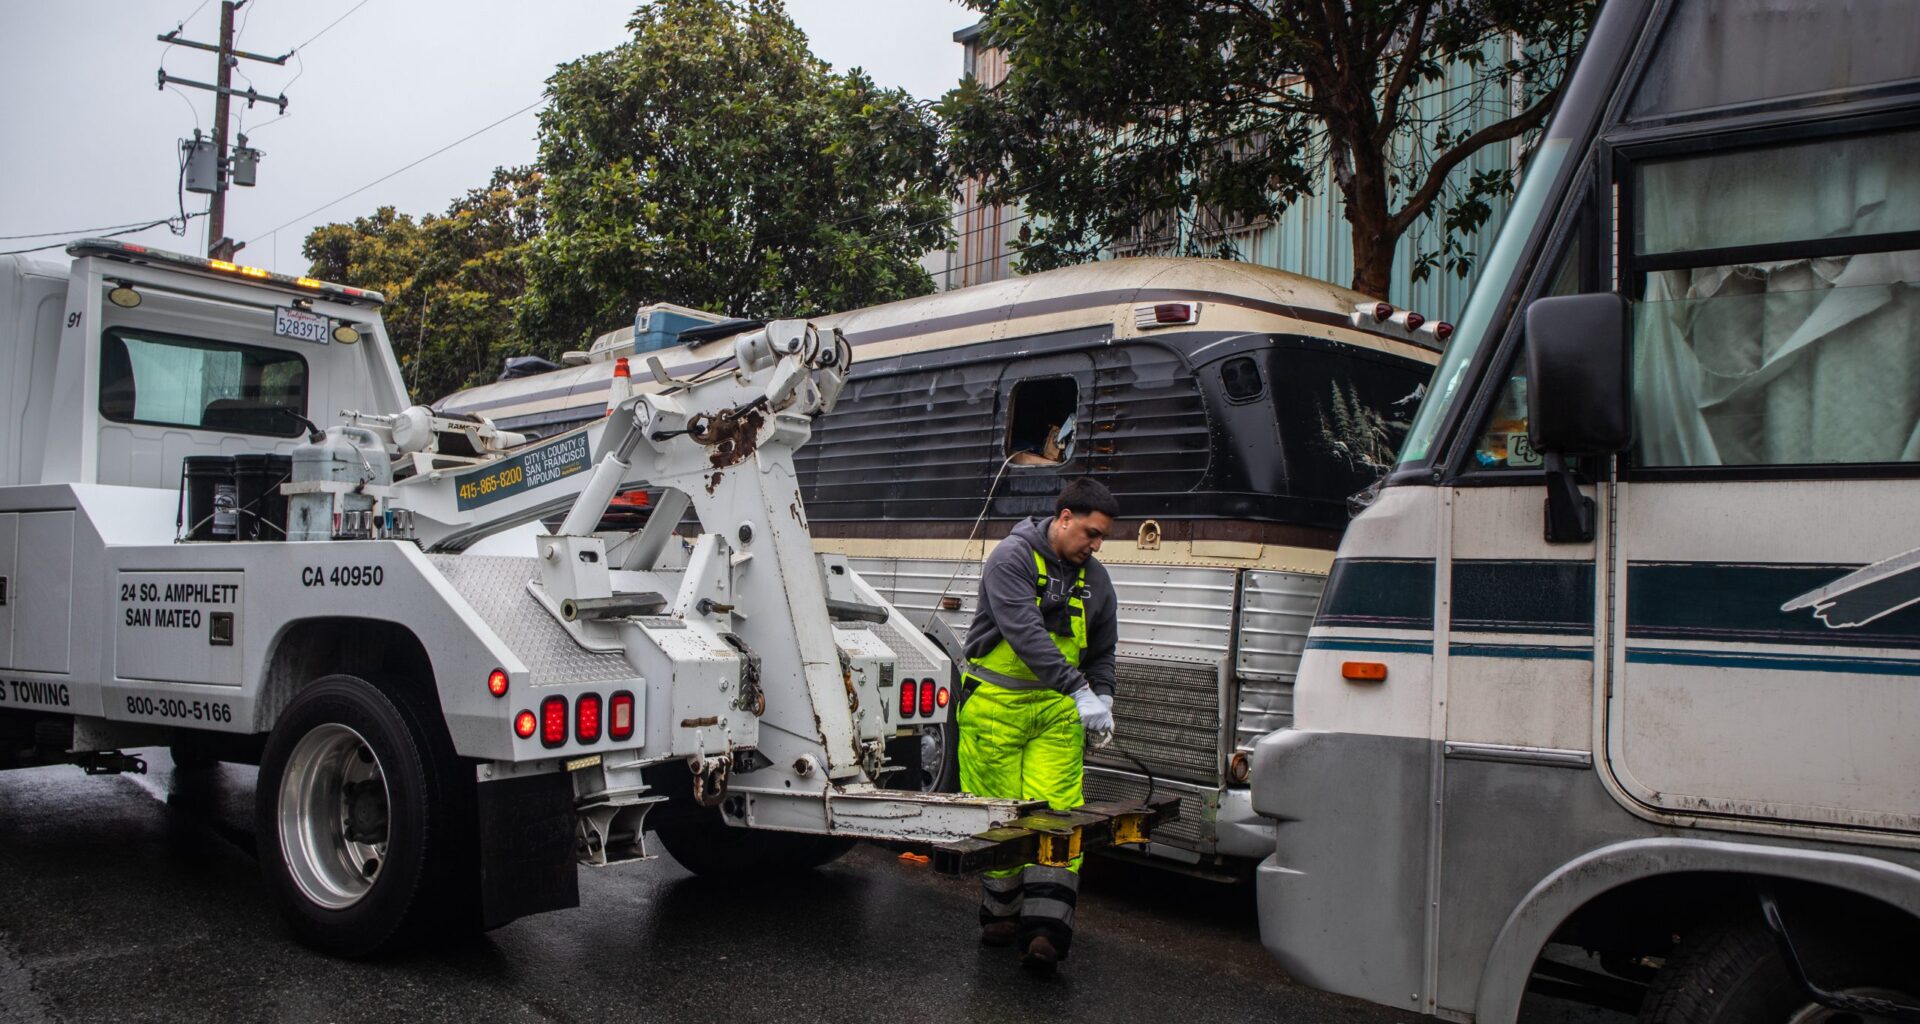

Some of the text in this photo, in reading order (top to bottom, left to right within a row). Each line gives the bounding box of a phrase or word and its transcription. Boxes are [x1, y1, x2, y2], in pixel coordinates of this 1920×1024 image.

[67, 311, 82, 328] 91
[279, 317, 326, 341] 52839T2
[448, 422, 480, 432] RAMY
[524, 436, 586, 466] CITY & COUNTY OF
[525, 462, 541, 477] SAN
[544, 447, 586, 470] FRANCISCO
[459, 466, 523, 499] 415-865-8200
[526, 467, 560, 487] IMPOUND
[302, 565, 384, 587] CA 40950
[121, 583, 239, 604] 24 SO. AMPHLETT
[125, 608, 201, 629] SAN MATEO
[10, 681, 70, 706] TOWING
[126, 696, 232, 723] 800-300-5166
